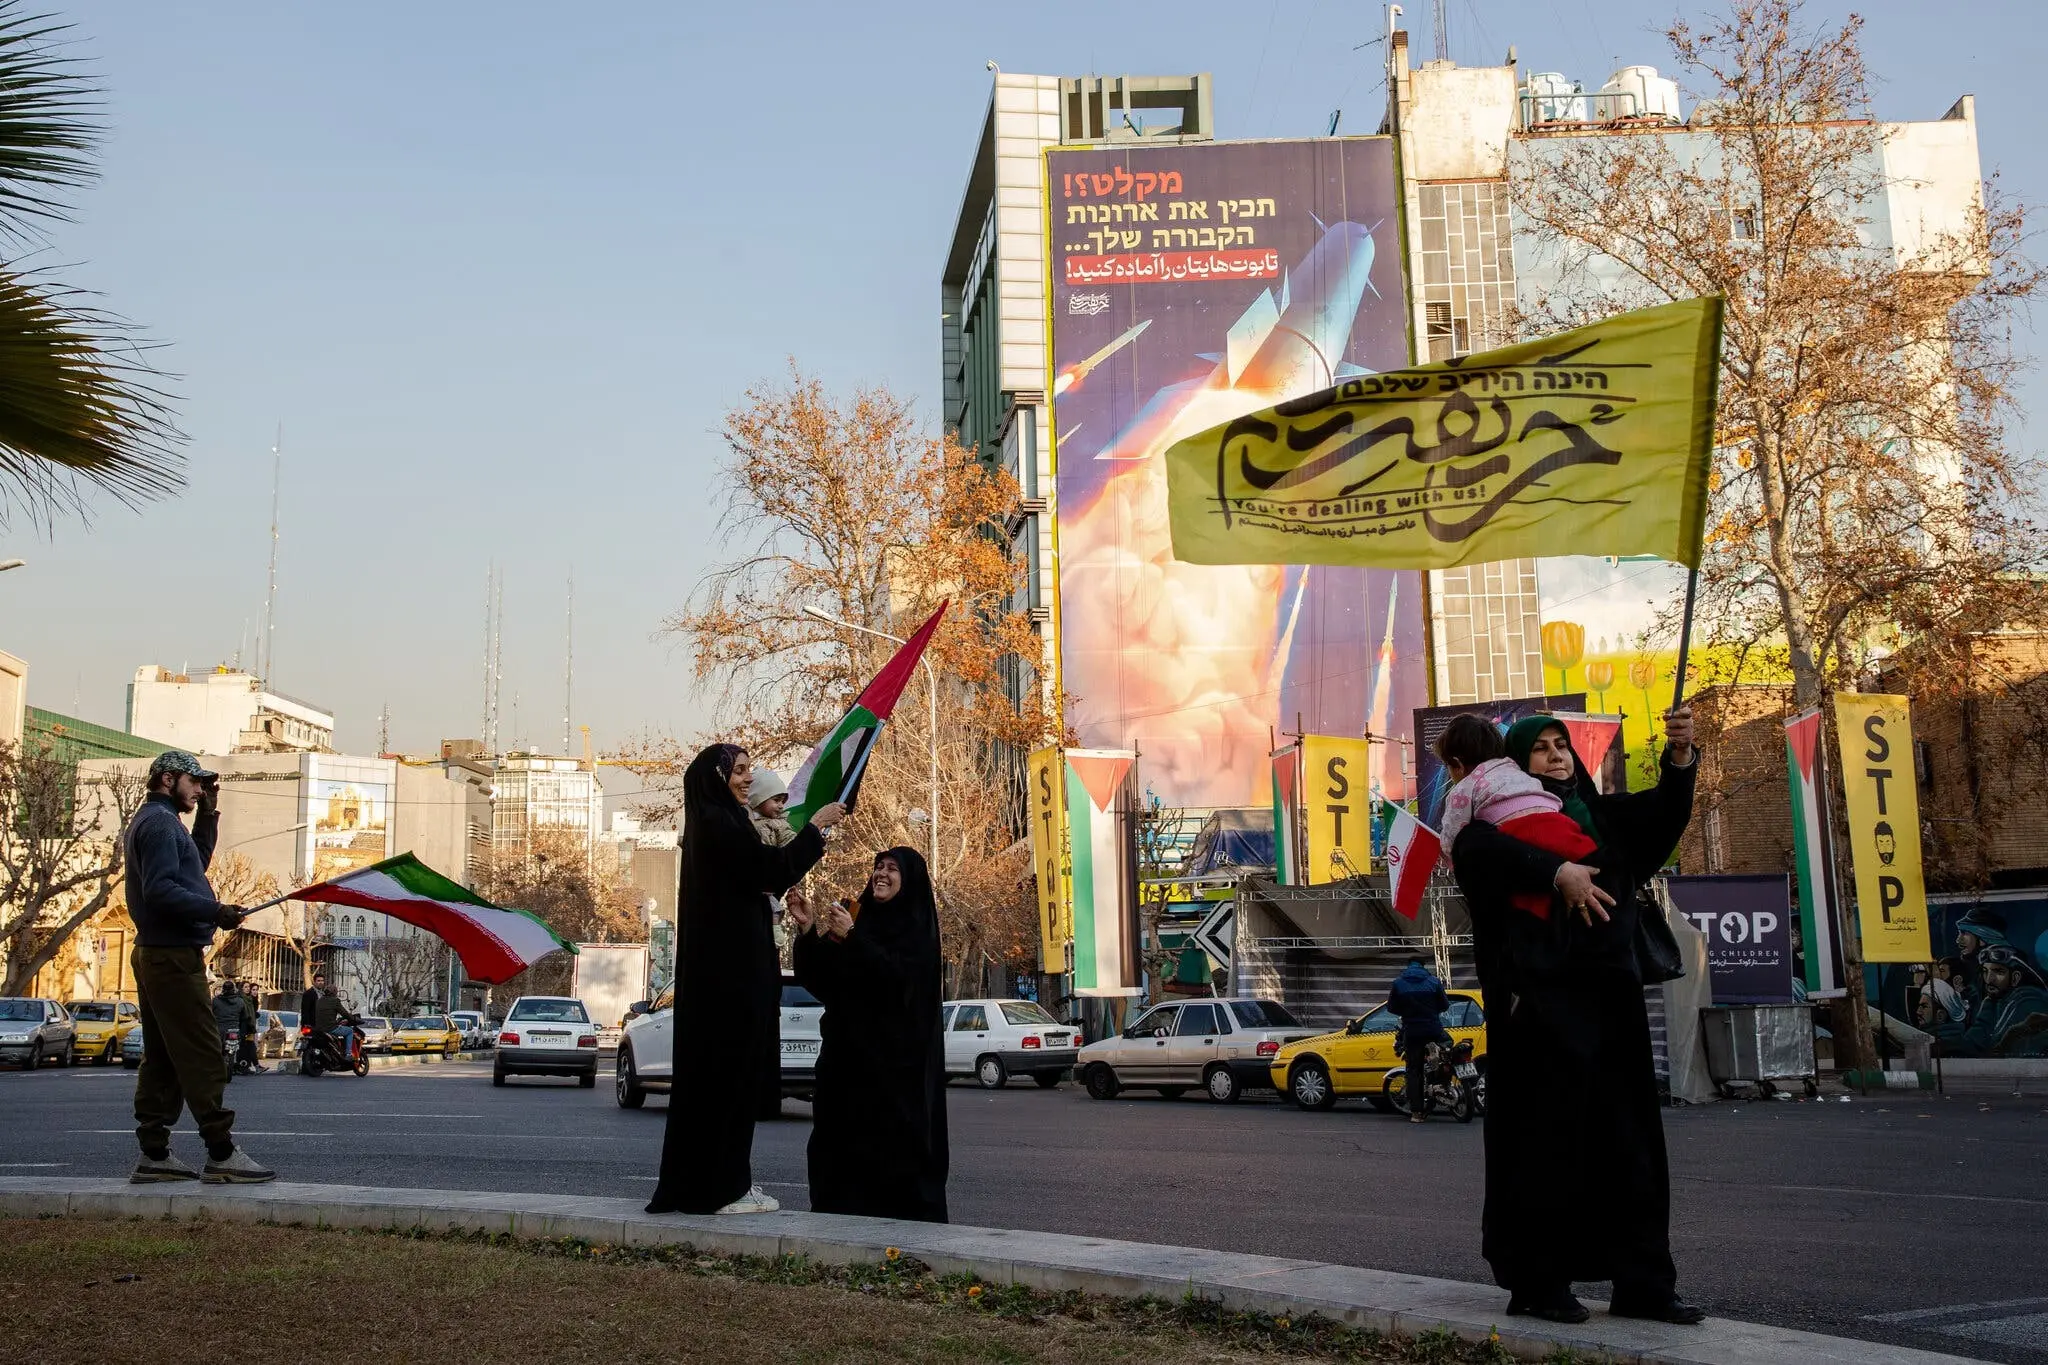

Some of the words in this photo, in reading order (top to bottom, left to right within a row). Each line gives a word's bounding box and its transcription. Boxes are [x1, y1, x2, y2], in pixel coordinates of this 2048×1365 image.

[1067, 202, 1159, 224] ארונות
[1168, 200, 1209, 220] את
[1217, 198, 1276, 224] תכין
[1152, 226, 1254, 251] הקבורה
[1066, 257, 1117, 282] کنید!
[1115, 252, 1161, 277] آماده
[1160, 256, 1171, 280] را
[1342, 375, 1430, 399] שלכם
[1438, 371, 1524, 392] היריב
[1533, 371, 1608, 390] הינה
[1234, 499, 1298, 517] You're
[1308, 498, 1387, 519] dealing
[1397, 490, 1443, 508] with
[1454, 484, 1486, 501] us!
[1680, 911, 1778, 943] TOP
